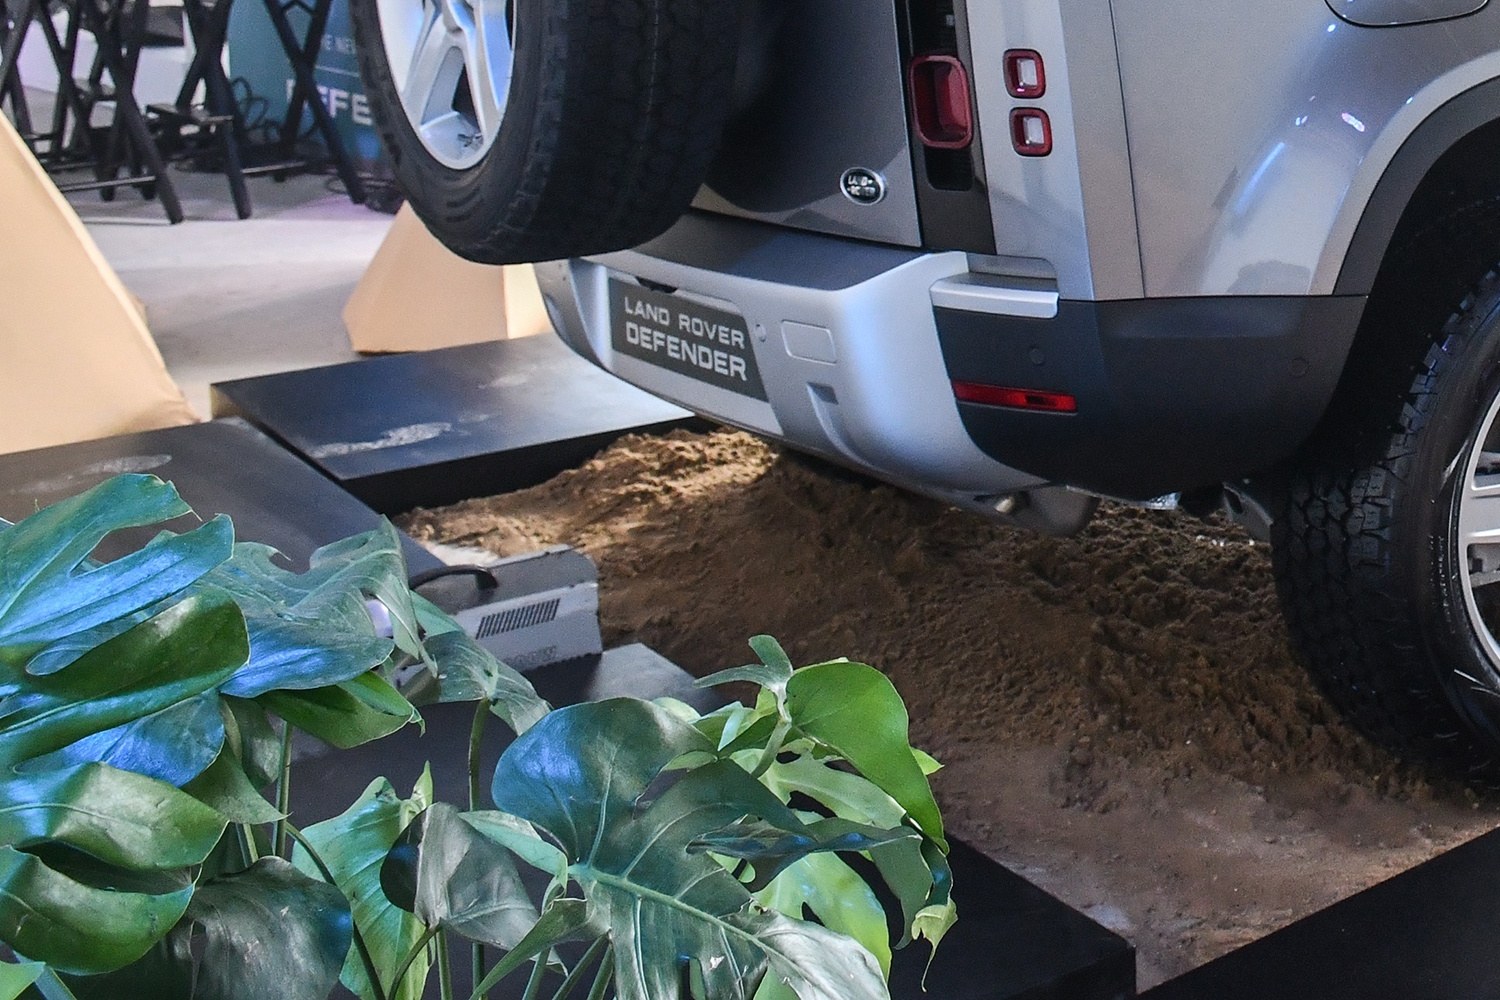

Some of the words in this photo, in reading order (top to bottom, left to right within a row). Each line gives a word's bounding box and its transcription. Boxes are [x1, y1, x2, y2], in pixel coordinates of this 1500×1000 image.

[624, 296, 670, 326] LAND
[678, 313, 745, 350] ROVER
[625, 321, 747, 382] DEFENDER
